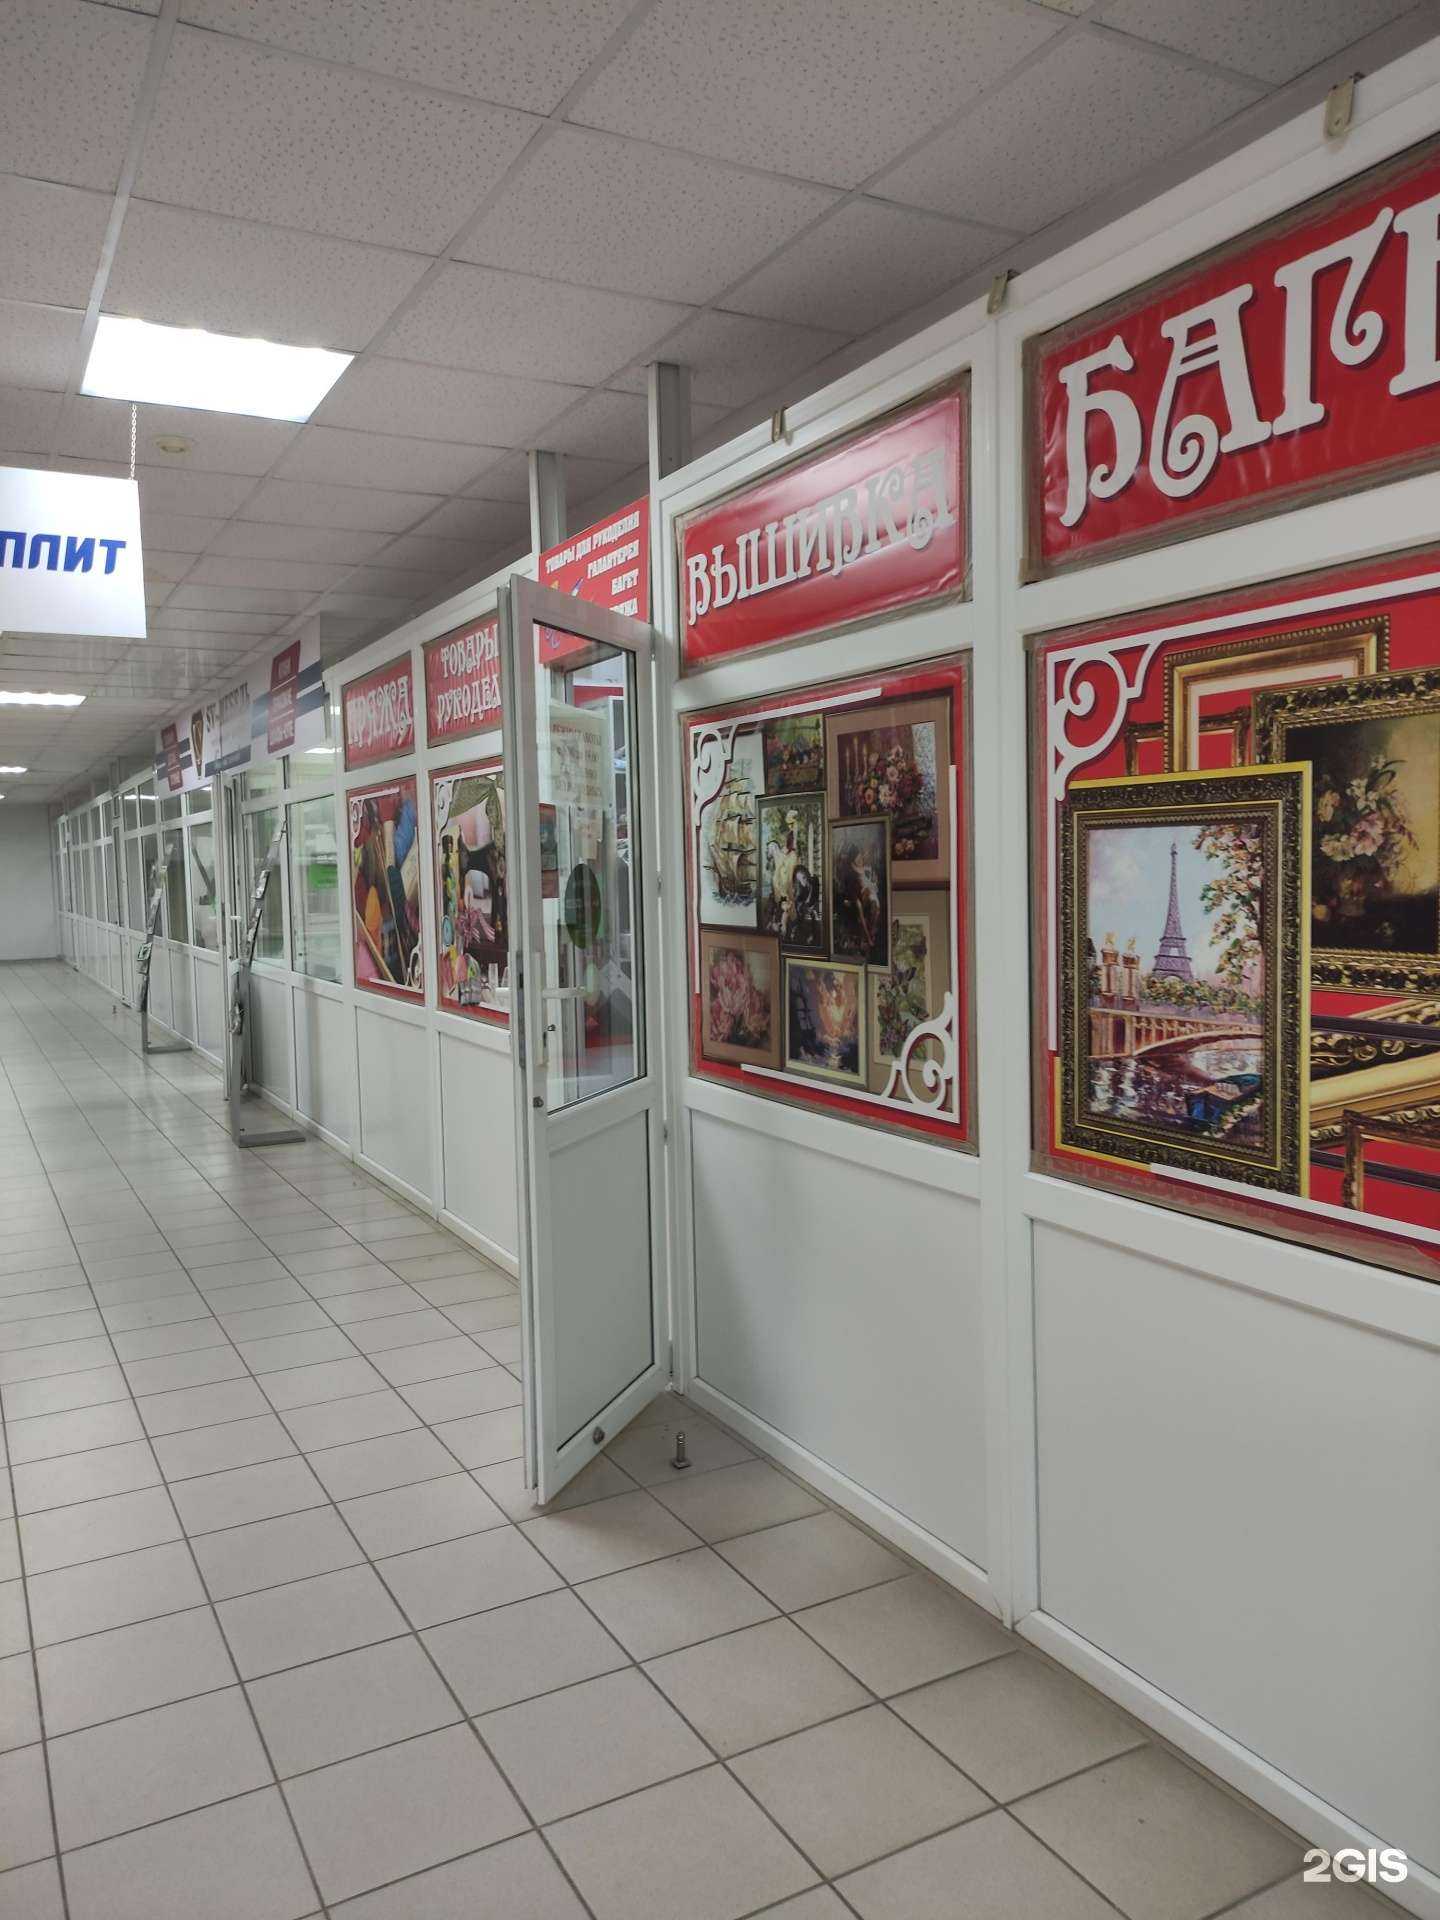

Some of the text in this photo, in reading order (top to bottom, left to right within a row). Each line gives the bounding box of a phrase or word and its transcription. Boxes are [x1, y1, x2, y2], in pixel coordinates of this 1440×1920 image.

[687, 447, 957, 625] ВЫШИВКА
[440, 623, 500, 679] ТОВАРЫ
[346, 675, 413, 748] ПРЯЖА
